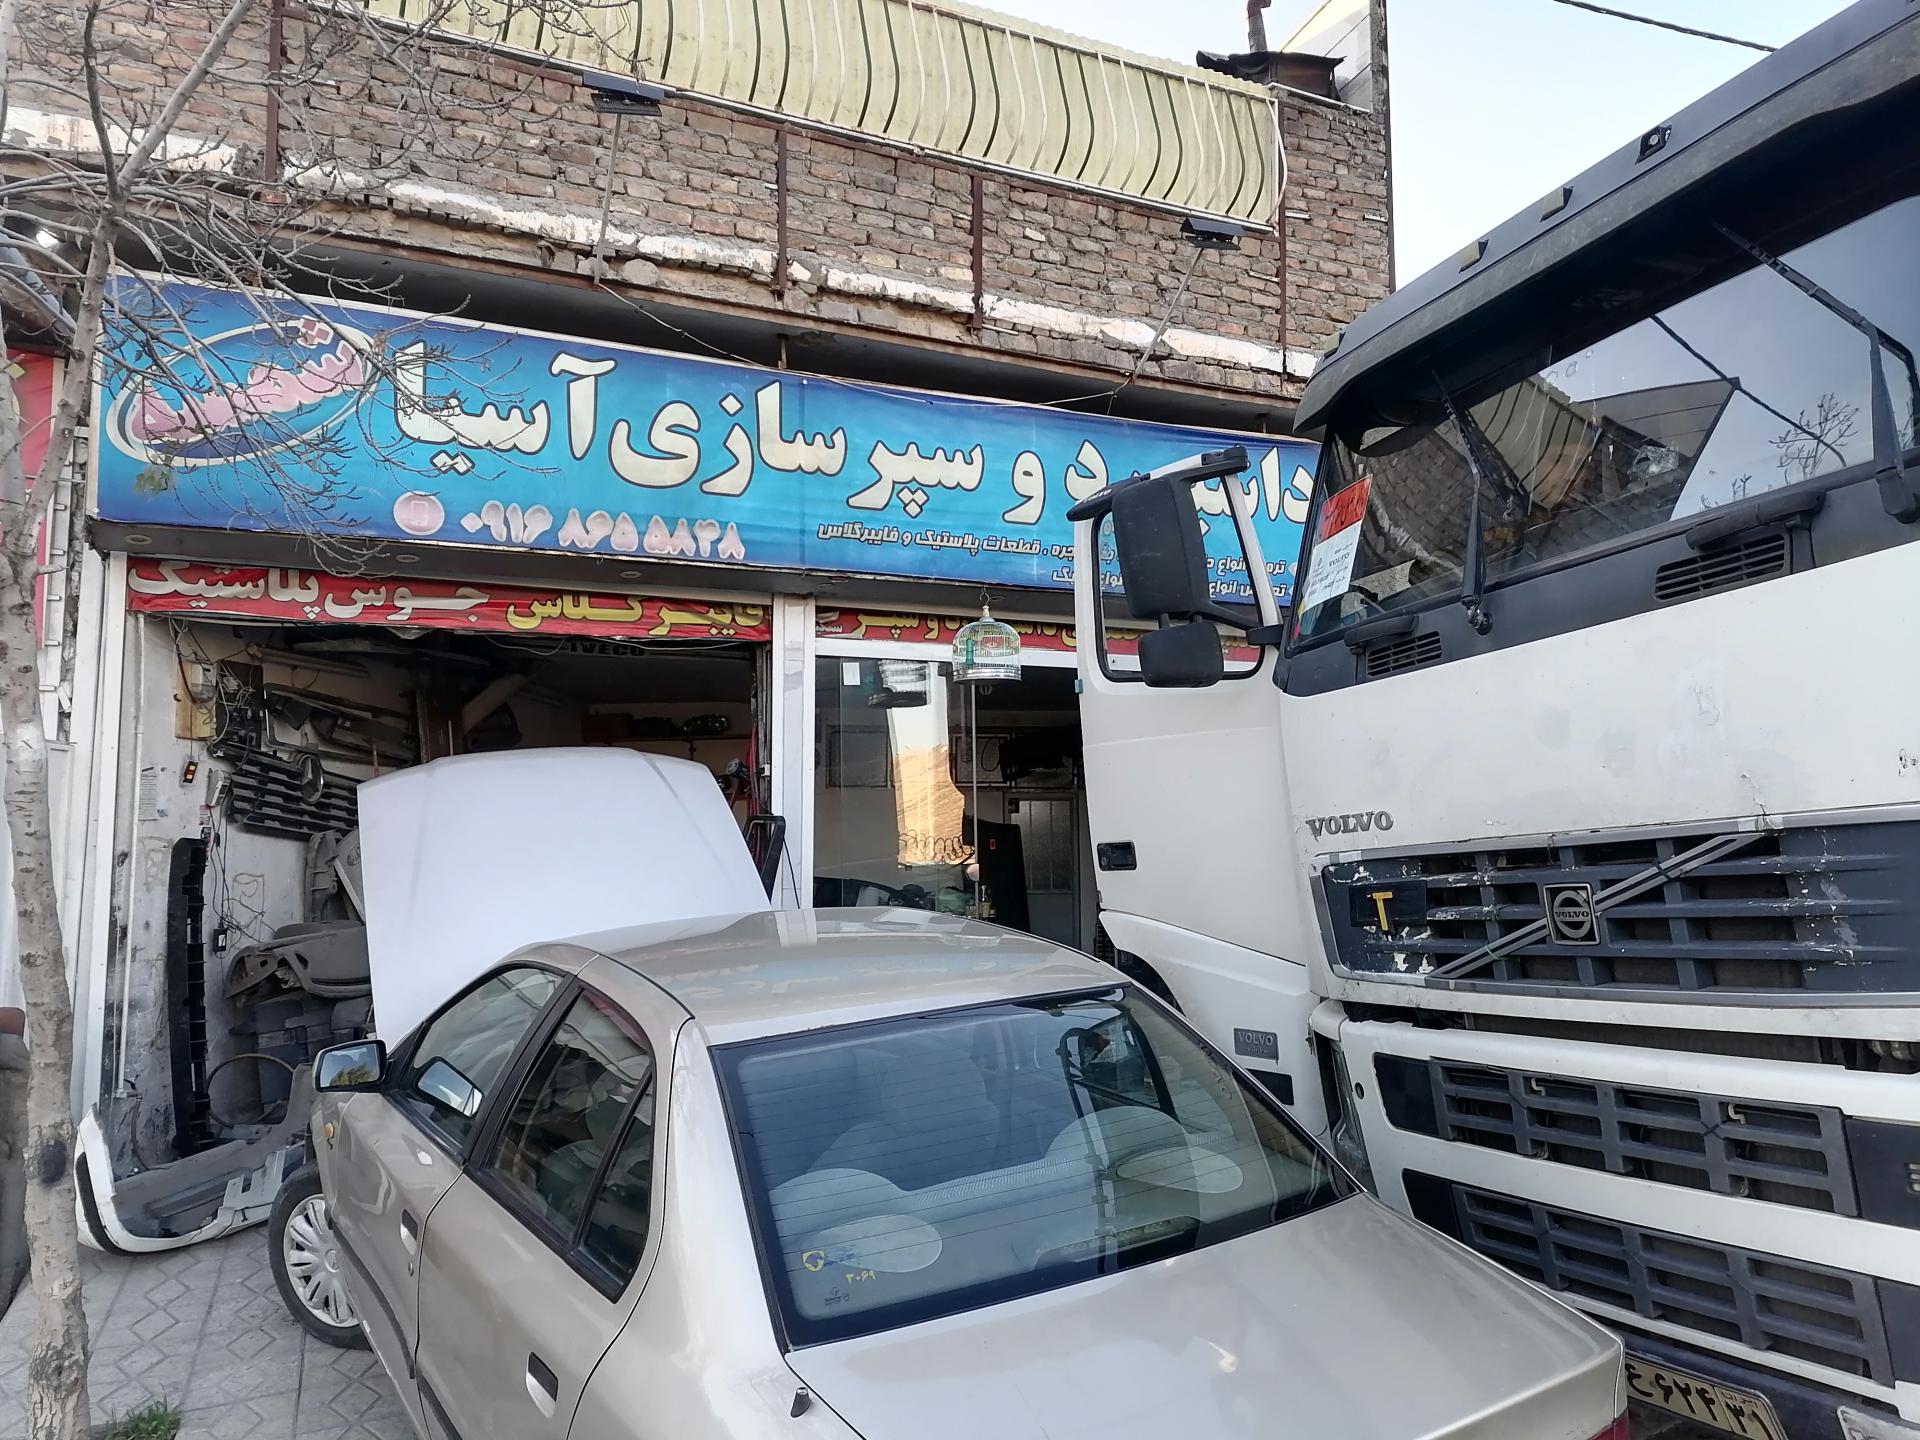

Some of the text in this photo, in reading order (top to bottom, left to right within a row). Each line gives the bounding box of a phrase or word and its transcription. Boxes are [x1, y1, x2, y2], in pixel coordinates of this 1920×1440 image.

[392, 340, 618, 476] آسیا
[606, 379, 848, 498] سازی
[846, 439, 985, 519] سپر
[1002, 450, 1046, 525] و
[901, 530, 913, 547] و
[914, 529, 980, 557] پلاستیک
[982, 535, 1042, 556] قطعات
[127, 560, 320, 620] پلاستیک
[1304, 810, 1394, 838] VOLVO
[1554, 910, 1590, 919] VOLVO
[1238, 1031, 1274, 1047] VOLVO
